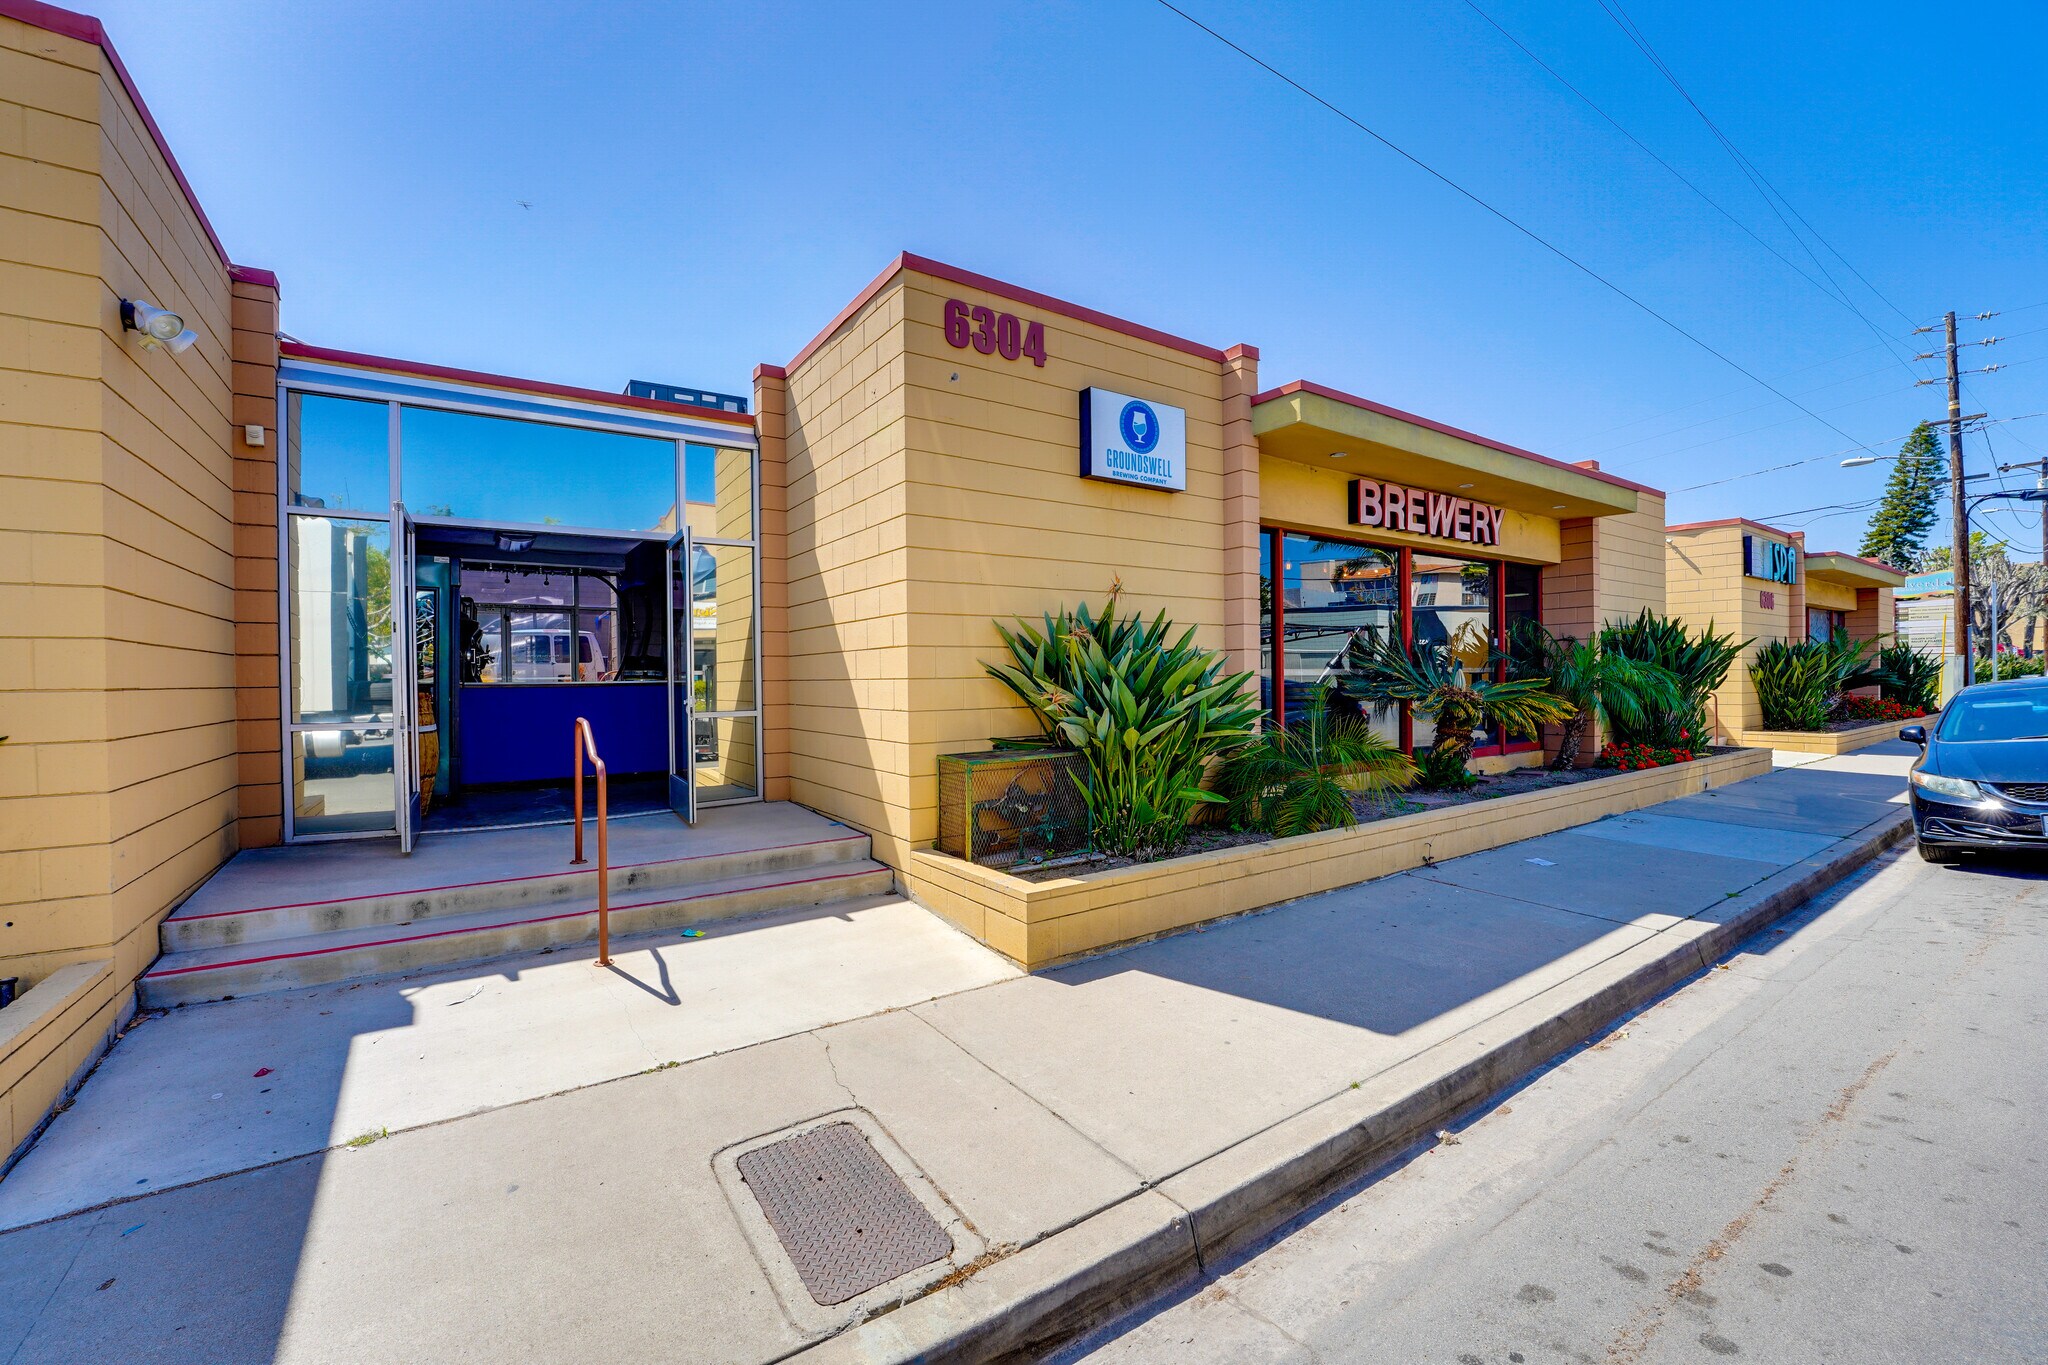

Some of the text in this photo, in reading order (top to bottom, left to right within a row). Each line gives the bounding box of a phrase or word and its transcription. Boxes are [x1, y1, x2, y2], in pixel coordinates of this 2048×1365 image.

[945, 299, 1047, 367] 6304
[1106, 449, 1172, 478] GROUNDSWELL
[1112, 470, 1167, 484] BREWING COMPANY
[1355, 479, 1506, 546] BREWERY
